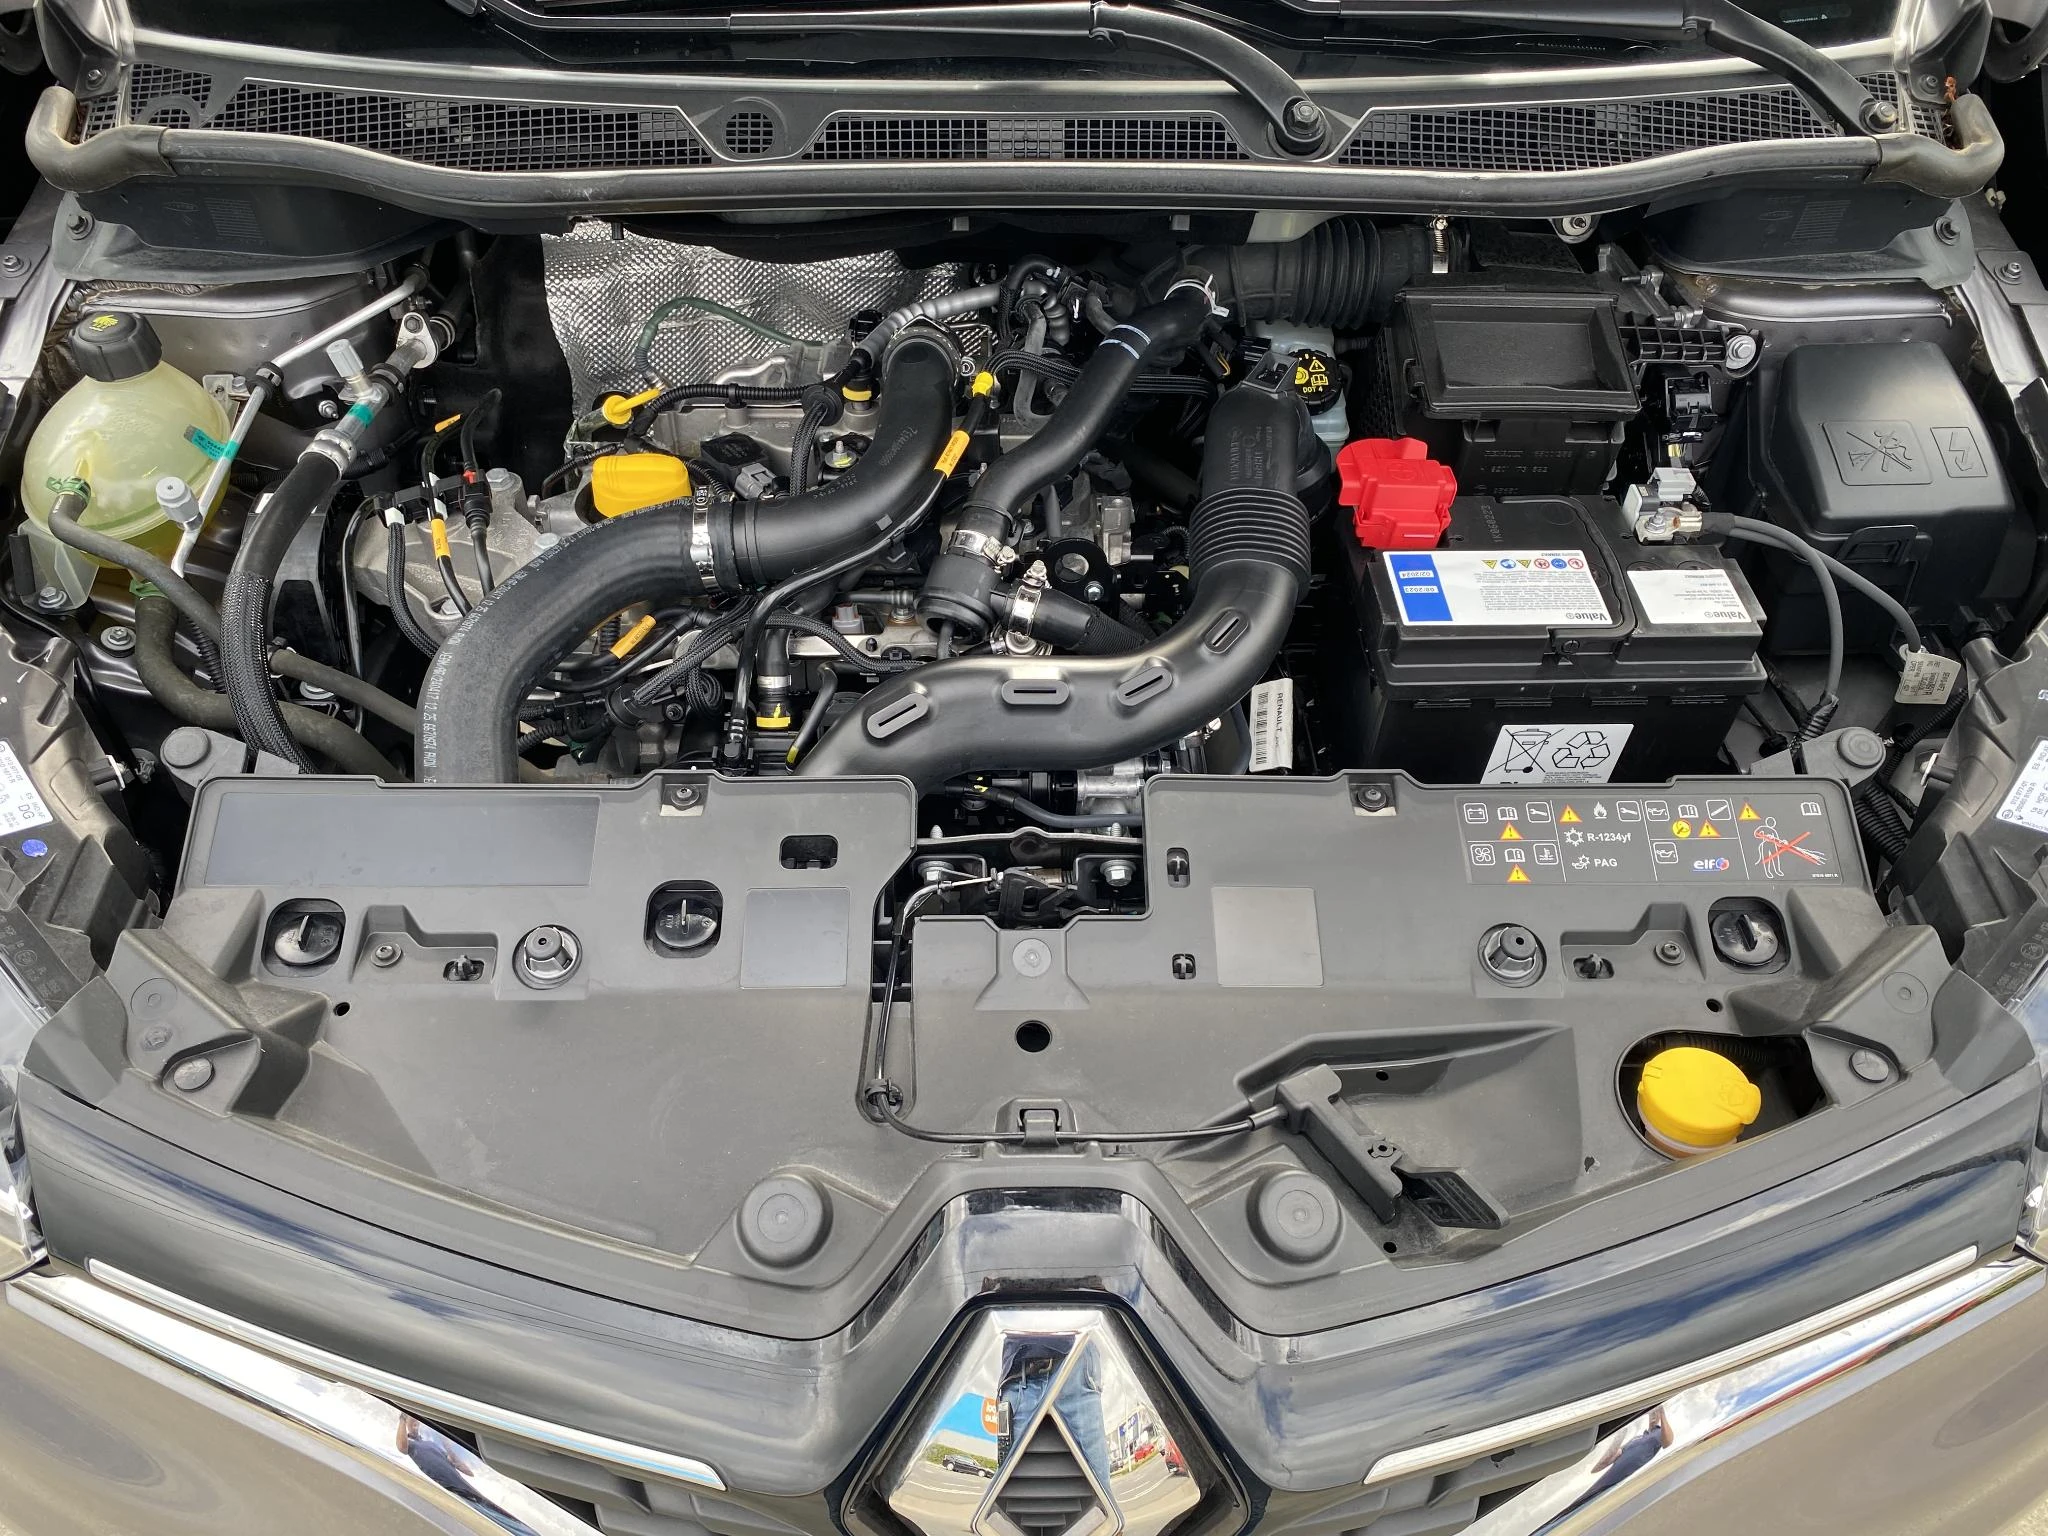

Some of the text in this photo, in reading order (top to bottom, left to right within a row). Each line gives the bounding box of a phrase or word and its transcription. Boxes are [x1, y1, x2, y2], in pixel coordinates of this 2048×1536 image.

[1302, 386, 1317, 394] DOT
[1275, 692, 1284, 732] RENAULT
[18, 804, 35, 820] DG
[1586, 832, 1631, 845] R-1234yf
[1594, 857, 1618, 869] PAG
[1693, 858, 1716, 870] elf
